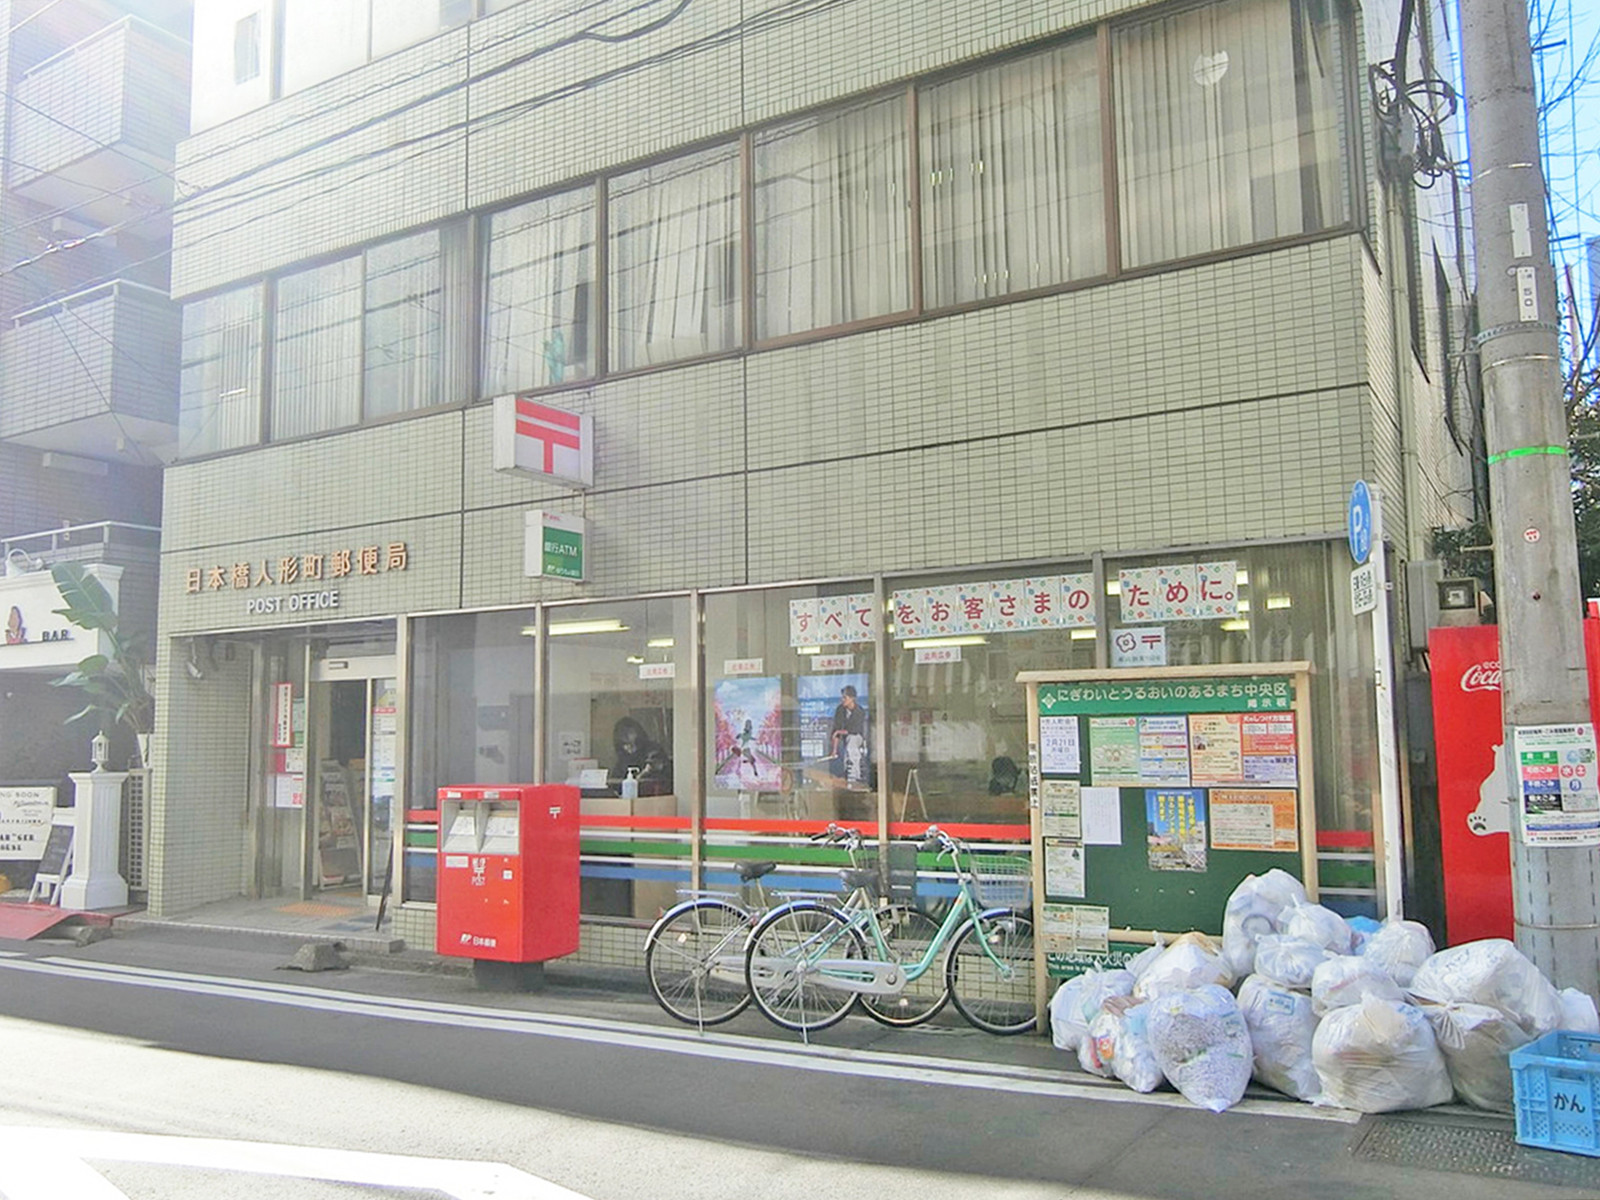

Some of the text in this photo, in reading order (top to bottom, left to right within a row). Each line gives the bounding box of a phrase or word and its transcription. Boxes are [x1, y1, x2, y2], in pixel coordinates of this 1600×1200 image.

[186, 542, 408, 594] 日本橋人形町郵便局
[247, 590, 340, 614] POST OFFICE
[796, 580, 1235, 633] すべて を、お客さまの ために。
[42, 629, 69, 641] BAR
[1056, 682, 1288, 701] にぎわいとうるおいのあるまち中央区
[1553, 1092, 1586, 1113] かん
